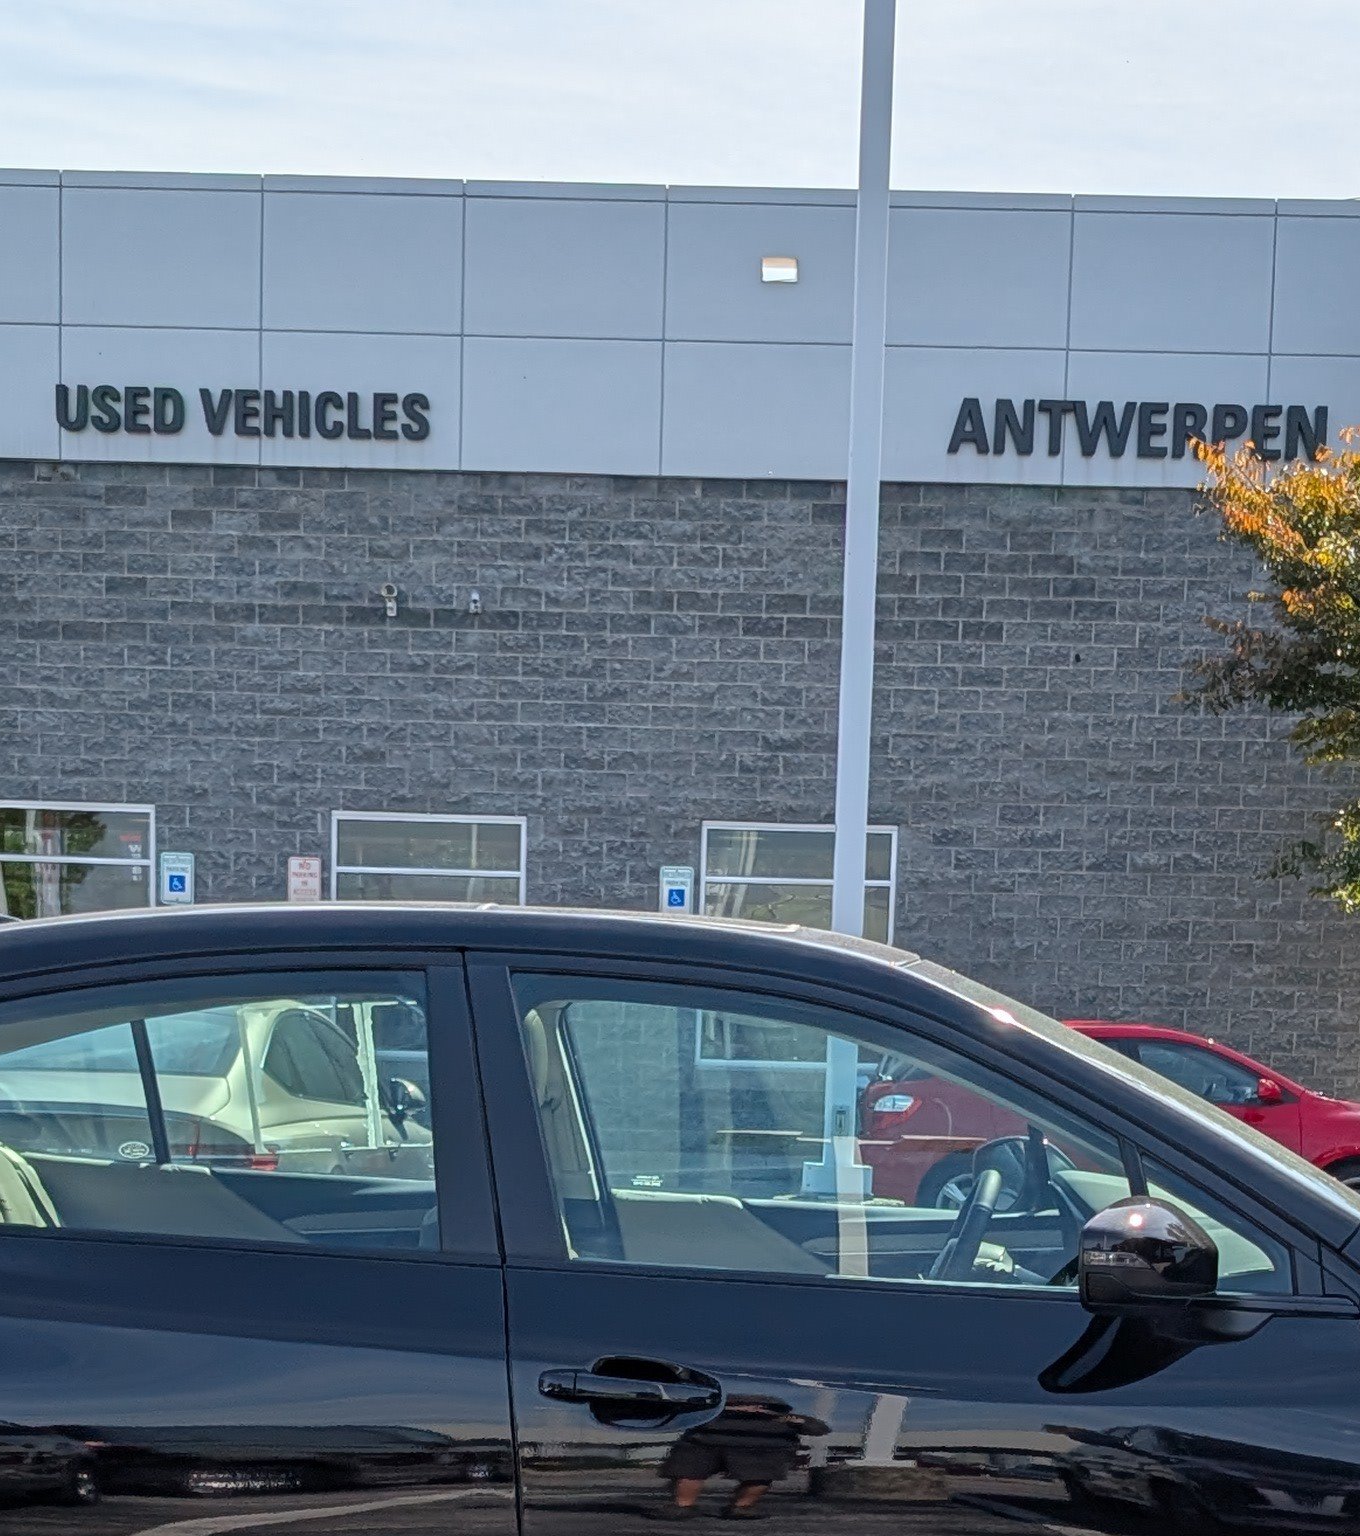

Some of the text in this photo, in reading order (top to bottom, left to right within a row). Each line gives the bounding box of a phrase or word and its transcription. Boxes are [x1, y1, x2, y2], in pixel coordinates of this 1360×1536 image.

[55, 384, 431, 441] USED VEHICLES
[947, 397, 1329, 462] ANTWERPEN
